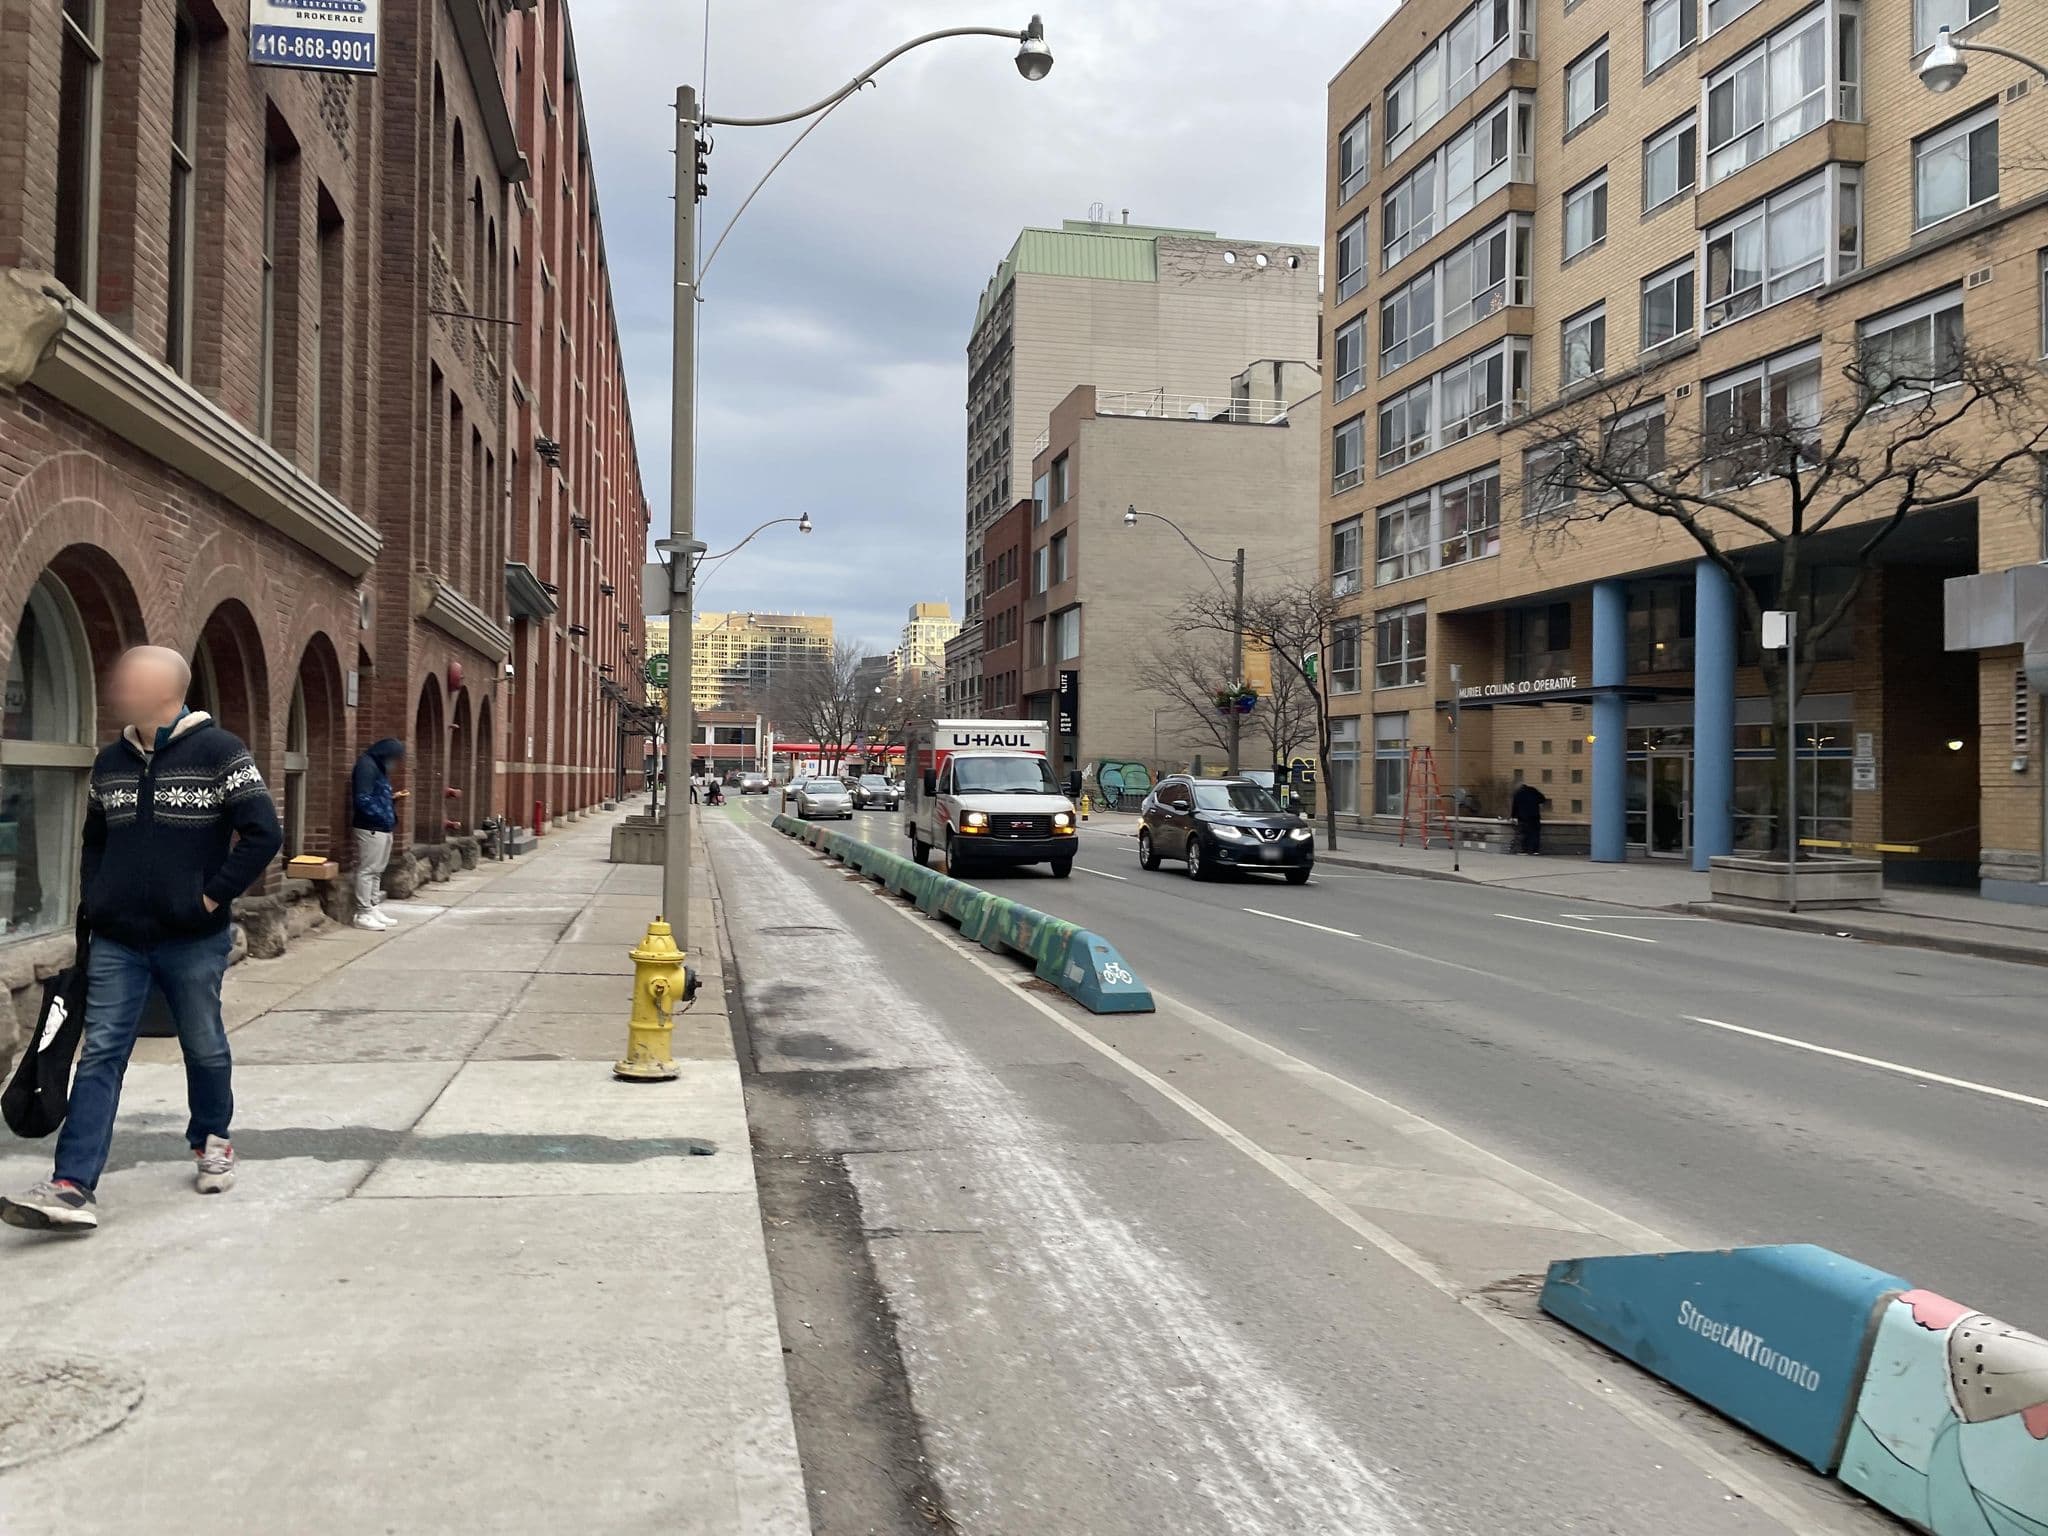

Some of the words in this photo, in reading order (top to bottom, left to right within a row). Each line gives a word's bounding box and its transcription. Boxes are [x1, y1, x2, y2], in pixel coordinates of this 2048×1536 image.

[302, 0, 339, 9] ESTATE
[296, 11, 364, 24] BROKERAGE
[256, 33, 371, 63] 416-868-9901
[1458, 685, 1482, 698] MURIEL
[1484, 682, 1515, 696] COLLINS
[1518, 680, 1531, 693] CO
[1533, 676, 1577, 692] OPERATIVE
[953, 734, 1031, 747] U-HAUL
[1677, 1300, 1821, 1392] StreetARToronto
